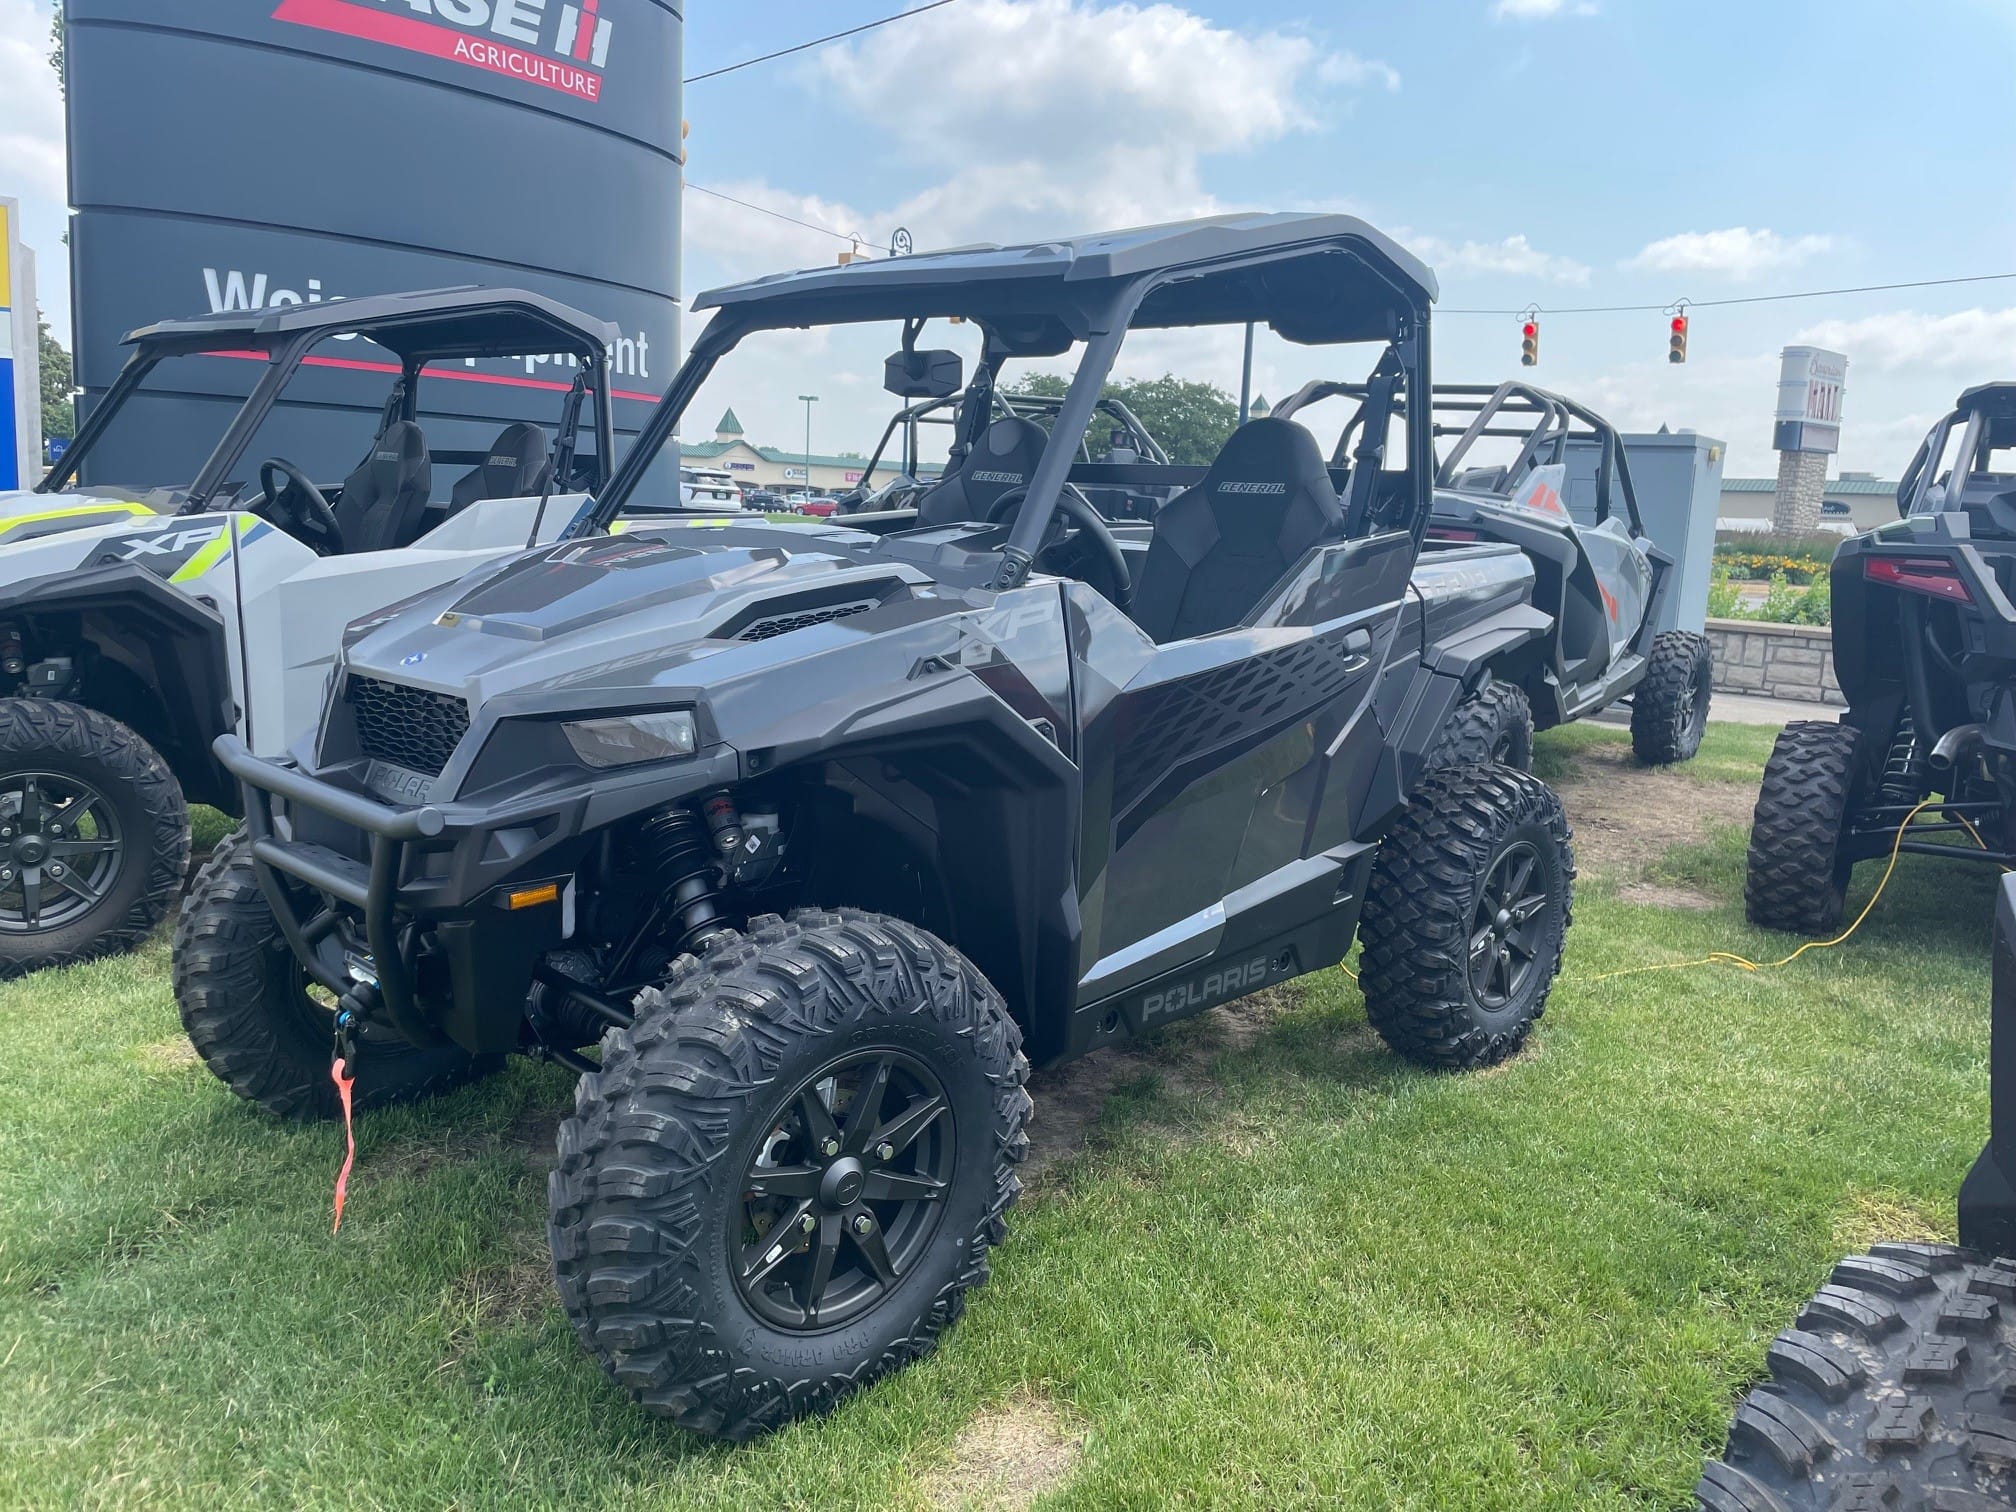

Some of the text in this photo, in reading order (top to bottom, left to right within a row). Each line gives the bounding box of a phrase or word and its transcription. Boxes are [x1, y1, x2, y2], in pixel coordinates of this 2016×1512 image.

[453, 37, 598, 97] AGRICULTURE
[971, 470, 1023, 484] GENERAL
[1217, 481, 1286, 494] GENERAL
[121, 525, 225, 560] XP
[939, 599, 1056, 656] XP
[1142, 955, 1268, 1023] POLARIS
